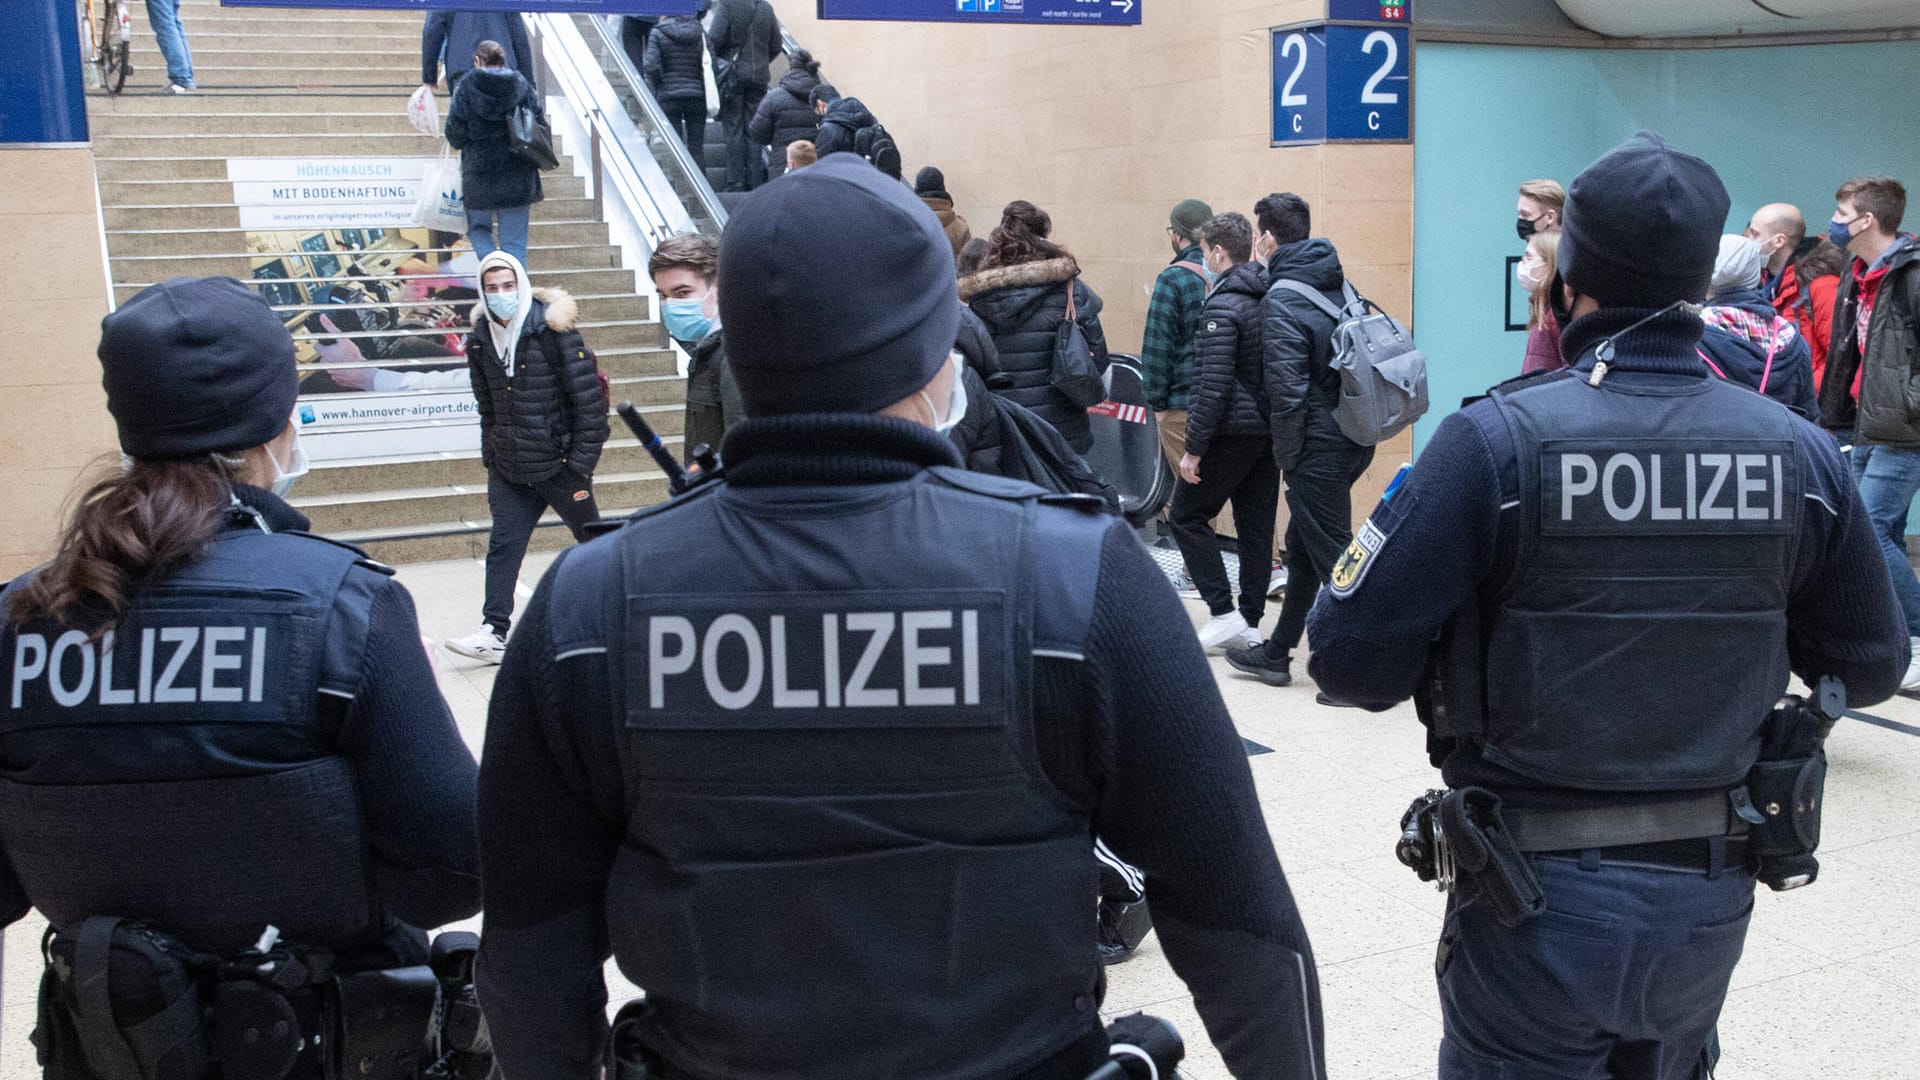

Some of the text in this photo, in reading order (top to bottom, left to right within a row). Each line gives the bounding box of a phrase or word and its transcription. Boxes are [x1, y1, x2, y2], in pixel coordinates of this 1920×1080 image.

[1385, 7, 1399, 18] S4
[1281, 33, 1307, 107] 2
[1361, 31, 1398, 104] 2
[1293, 114, 1302, 132] C
[1368, 111, 1380, 130] C
[297, 163, 392, 176] HÖHENRAUSCH
[273, 188, 297, 199] MIT
[303, 186, 406, 199] BODENHAFTUNG
[1561, 452, 1783, 522] POLIZEI
[11, 627, 267, 709] POLIZEI
[649, 610, 980, 709] POLIZEI
